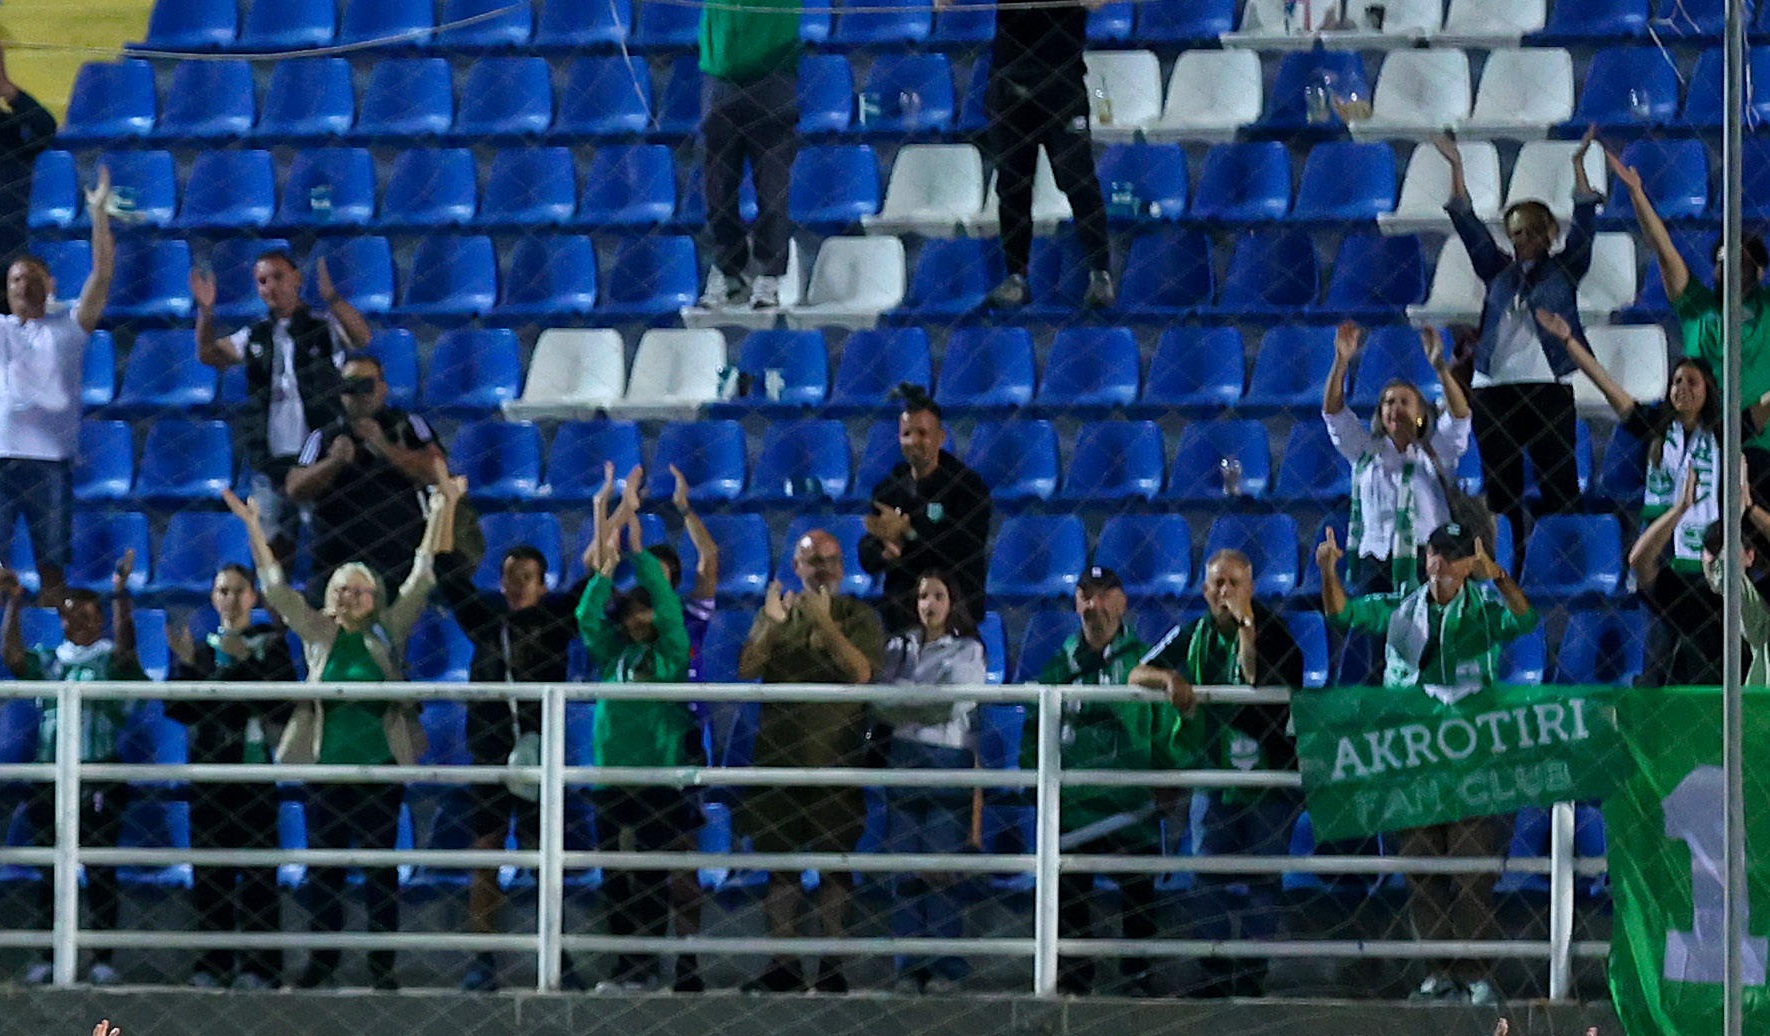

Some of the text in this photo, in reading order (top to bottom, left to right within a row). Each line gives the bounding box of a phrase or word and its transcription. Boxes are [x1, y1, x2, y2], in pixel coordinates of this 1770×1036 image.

[1331, 697, 1590, 781] AKROTIRI
[1354, 759, 1572, 825] FAN CLUB
